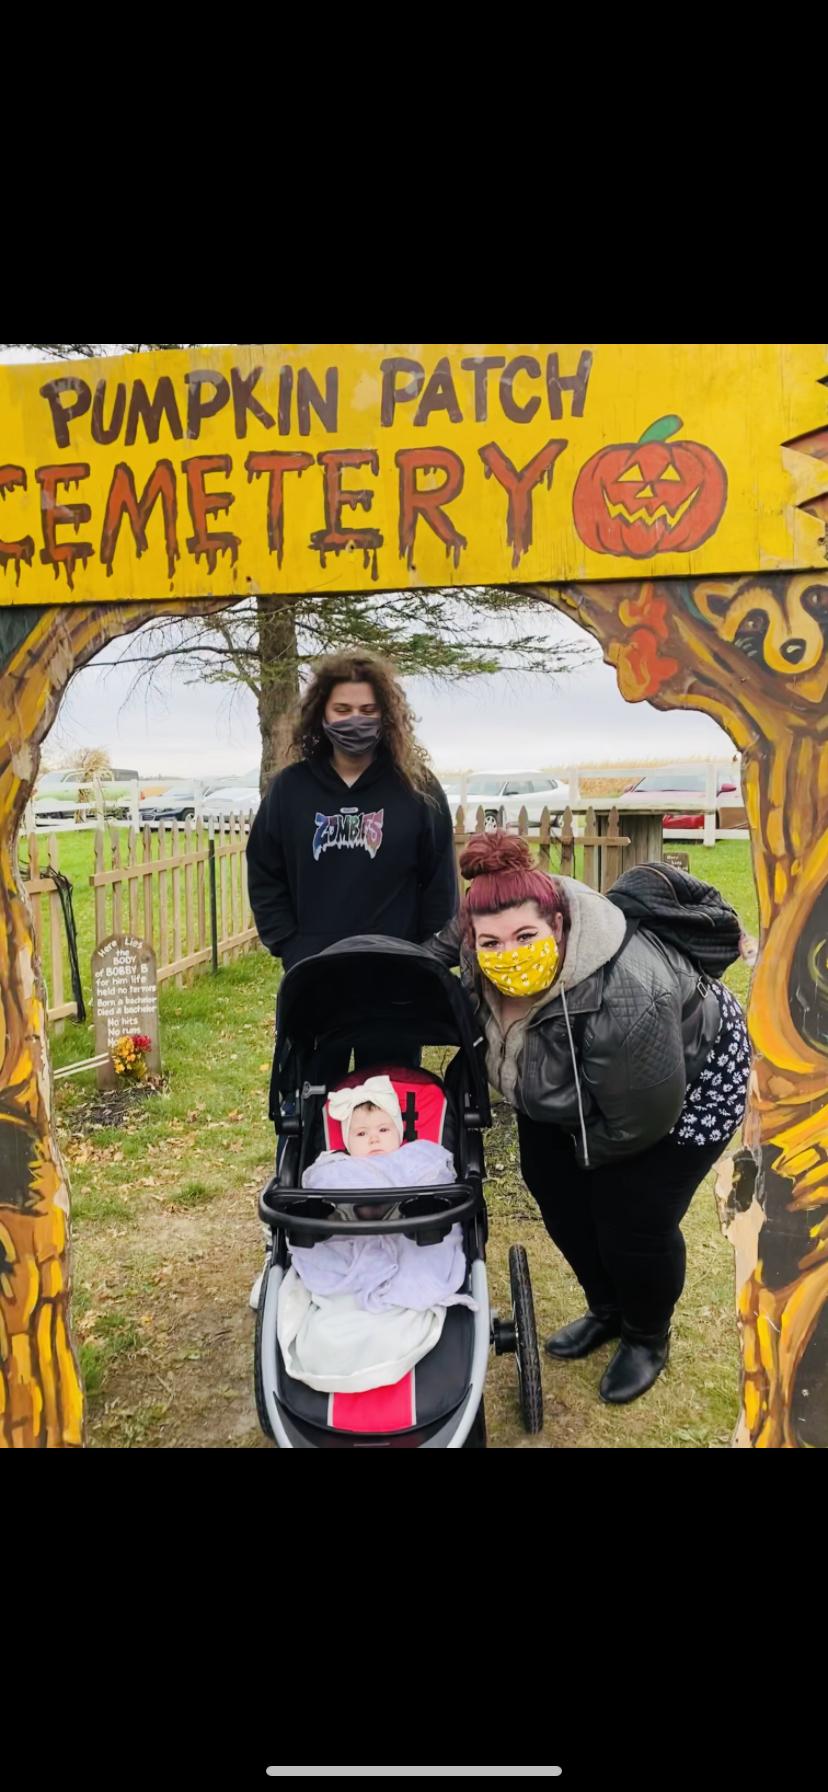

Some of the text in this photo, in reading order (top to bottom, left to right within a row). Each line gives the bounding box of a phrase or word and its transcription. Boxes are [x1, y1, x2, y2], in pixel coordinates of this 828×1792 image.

[39, 350, 593, 448] PUMPKIN PATCH
[97, 936, 143, 957] Here Lies
[116, 949, 129, 957] the
[113, 955, 136, 965] BODY
[106, 965, 137, 976] BOBBY
[96, 978, 109, 986] for
[131, 974, 147, 984] life
[97, 986, 115, 996] held
[97, 998, 115, 1007] Born
[97, 1007, 114, 1016] Died
[107, 1016, 138, 1027] No hits
[108, 1028, 120, 1037] No
